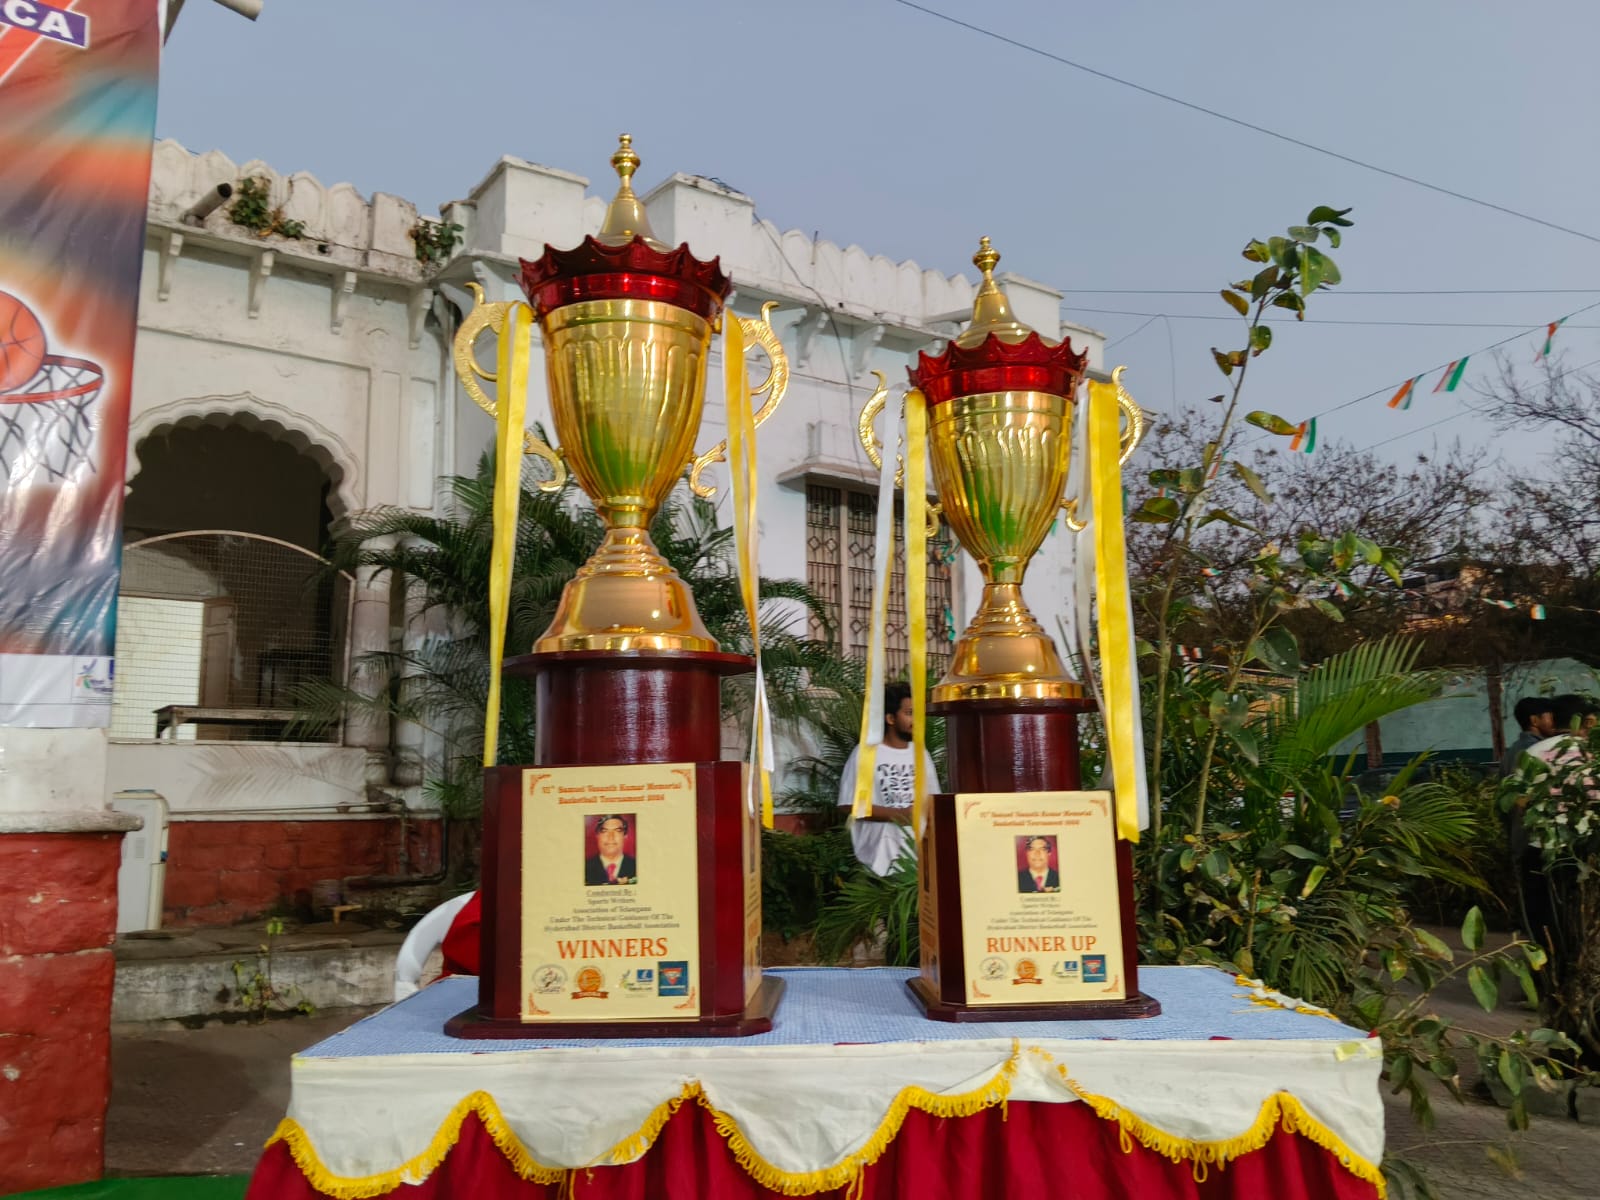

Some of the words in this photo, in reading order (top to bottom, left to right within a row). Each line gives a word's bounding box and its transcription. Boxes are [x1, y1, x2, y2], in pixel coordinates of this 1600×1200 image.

[600, 795, 644, 804] Tournament
[557, 937, 668, 959] WINNERS
[986, 936, 1067, 953] RUNNER
[1071, 935, 1097, 951] UP
